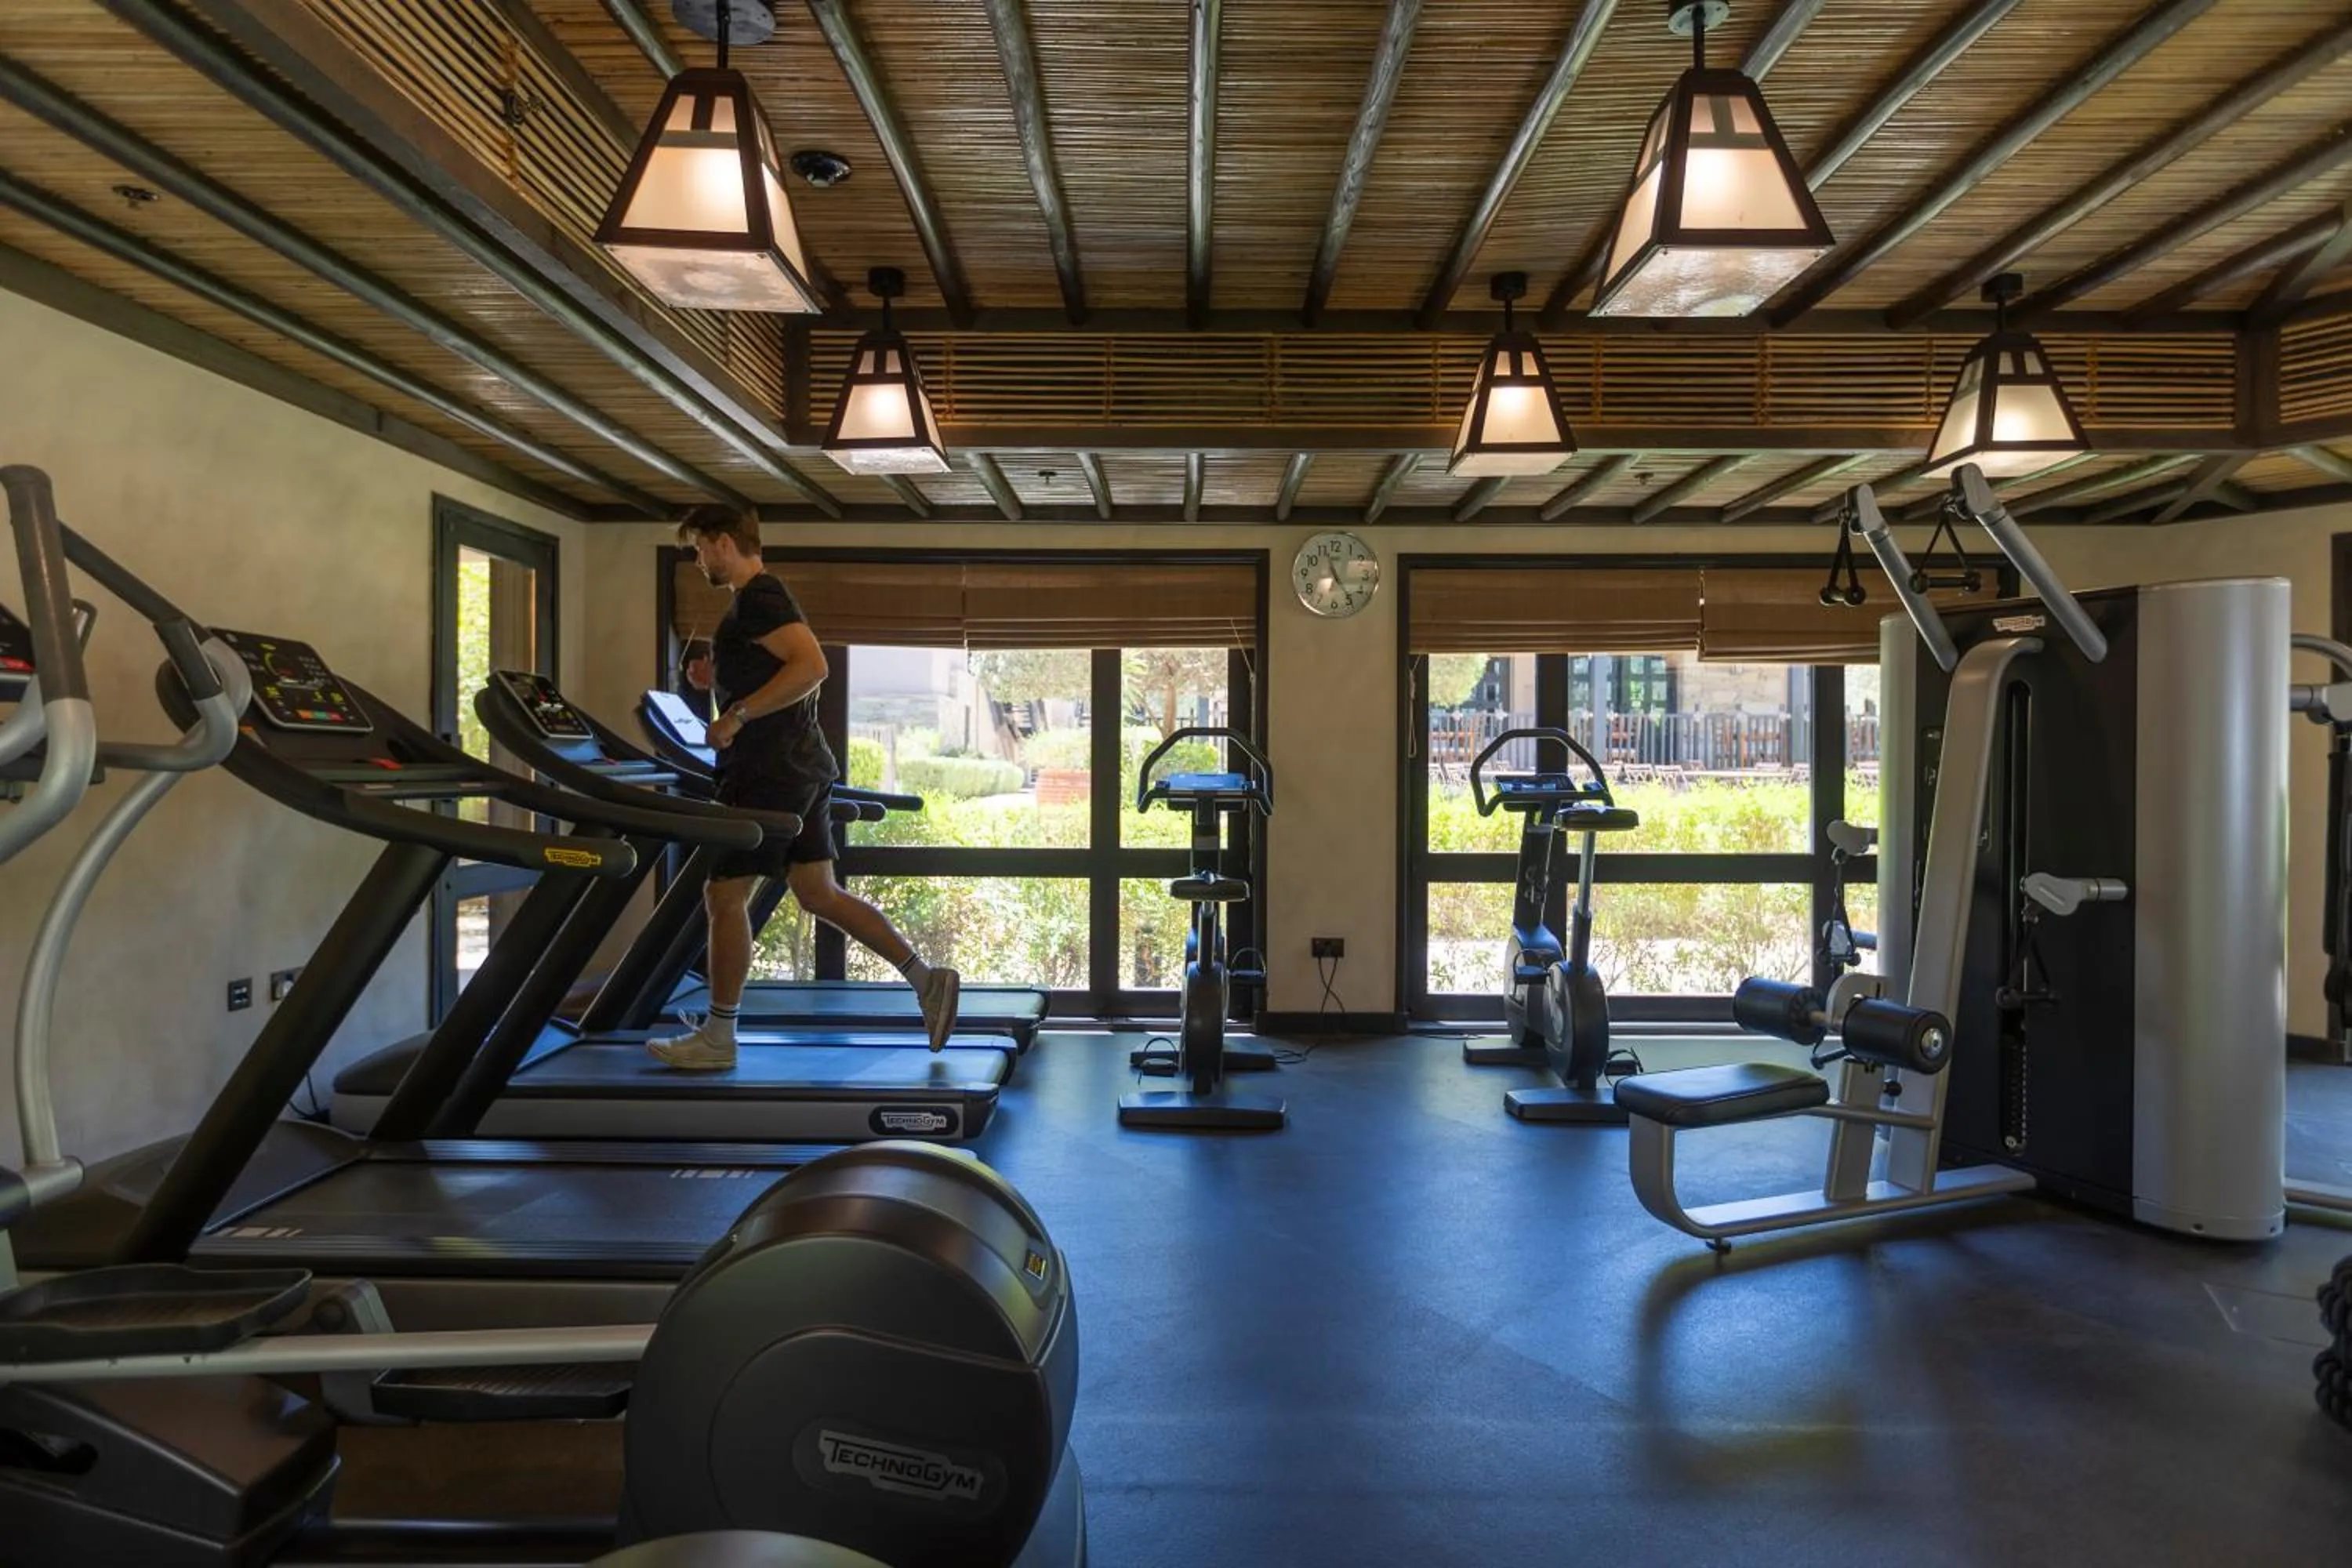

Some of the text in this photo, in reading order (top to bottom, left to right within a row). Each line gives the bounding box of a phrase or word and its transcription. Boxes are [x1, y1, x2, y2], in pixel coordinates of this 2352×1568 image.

[1318, 545, 1327, 557] 11
[1330, 540, 1341, 553] 12
[1306, 554, 1318, 567] 10
[1301, 568, 1308, 579] 9
[1362, 570, 1370, 582] 3
[1305, 583, 1314, 594] 8
[1345, 593, 1353, 606] 5
[824, 1436, 978, 1491] TECHNOGYM
